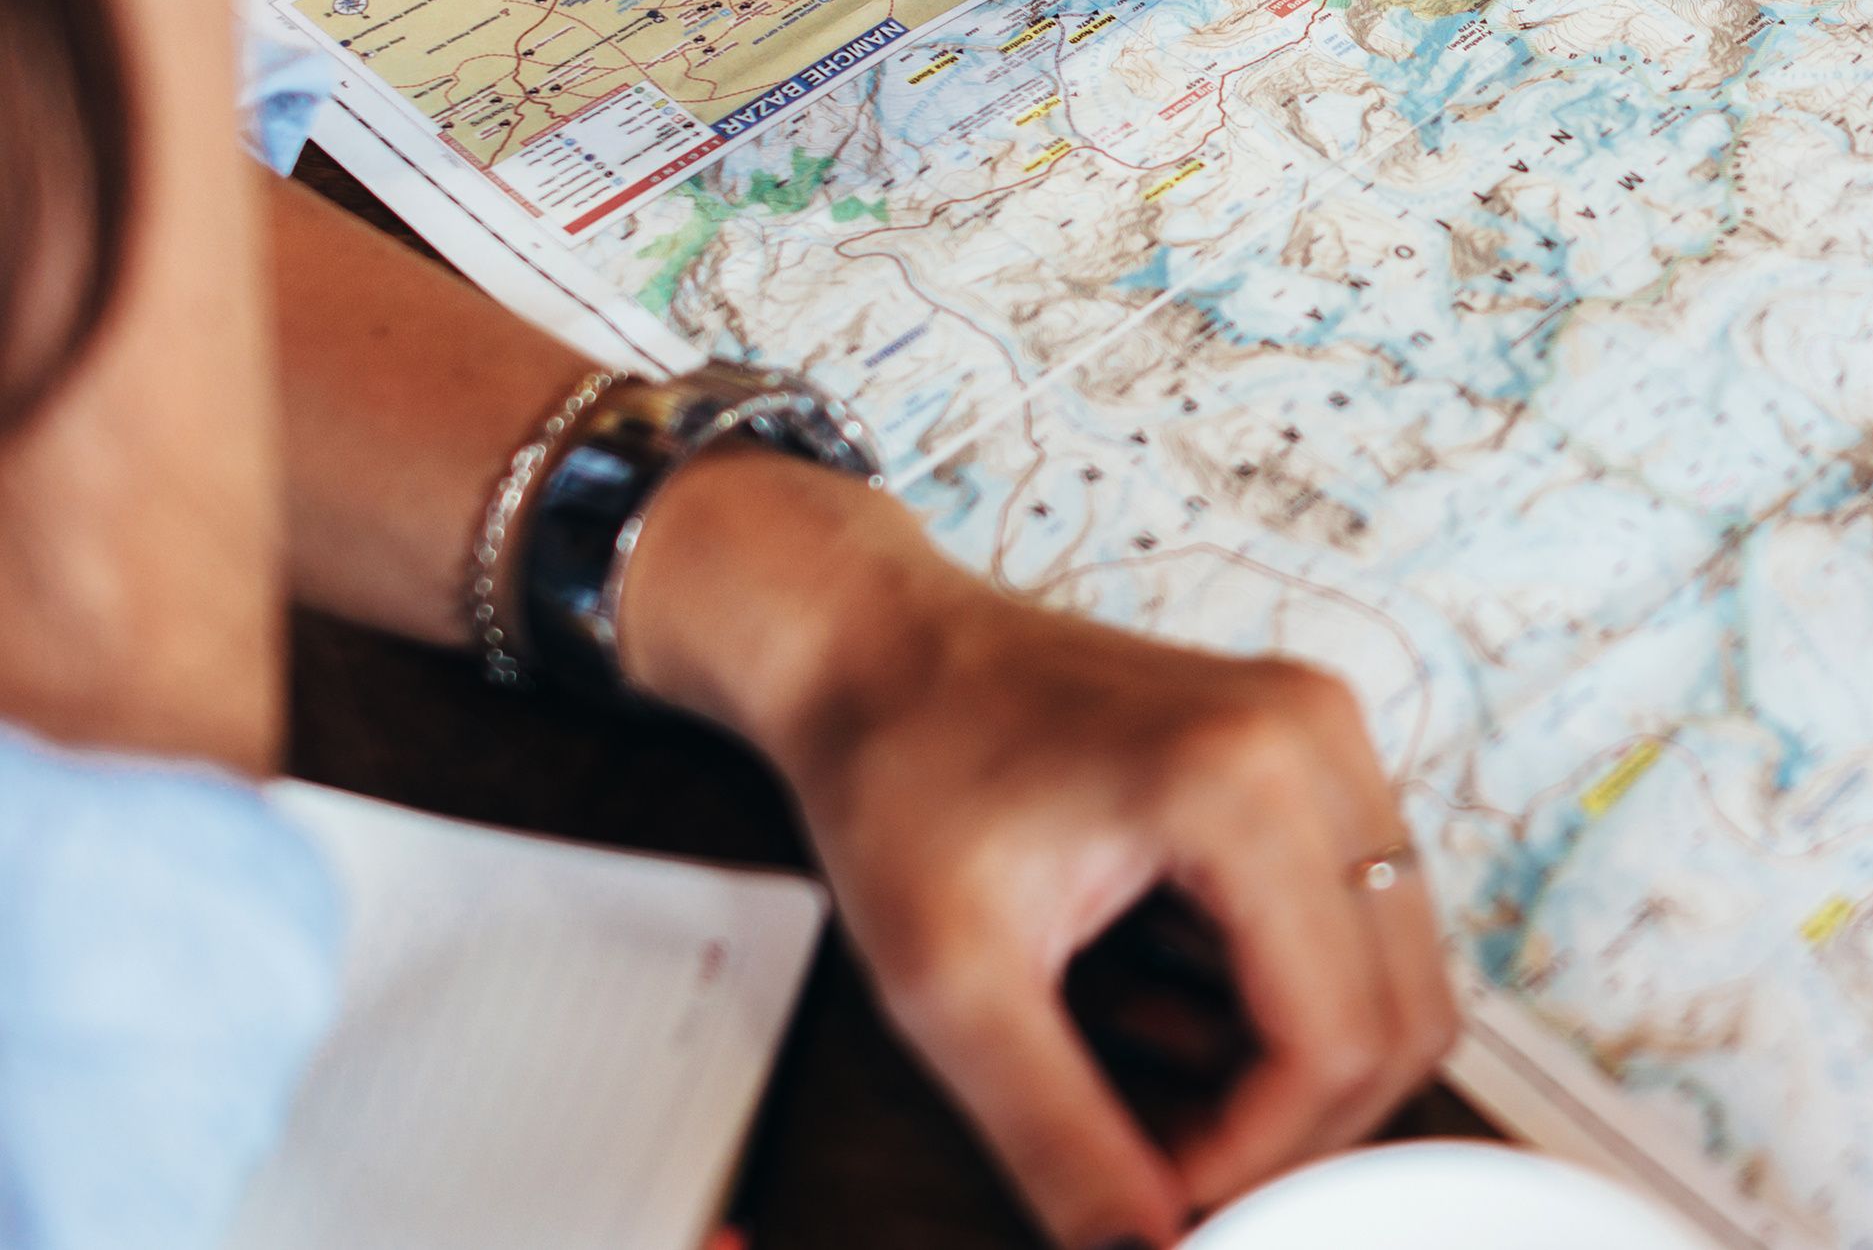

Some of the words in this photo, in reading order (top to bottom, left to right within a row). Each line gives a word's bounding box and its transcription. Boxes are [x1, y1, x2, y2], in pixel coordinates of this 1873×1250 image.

[1030, 18, 1055, 37] Mera
[1092, 13, 1115, 30] Mera
[999, 33, 1031, 54] Central
[1067, 26, 1093, 45] North
[1460, 27, 1493, 52] Kyashar
[799, 18, 900, 88] NAMCHE
[934, 53, 958, 70] Mera
[907, 66, 934, 85] South
[717, 78, 803, 138] BAZAR
[1041, 95, 1061, 111] High
[1159, 91, 1199, 119] Kharka
[1013, 108, 1039, 126] Camp
[648, 137, 721, 185] LEGEND
